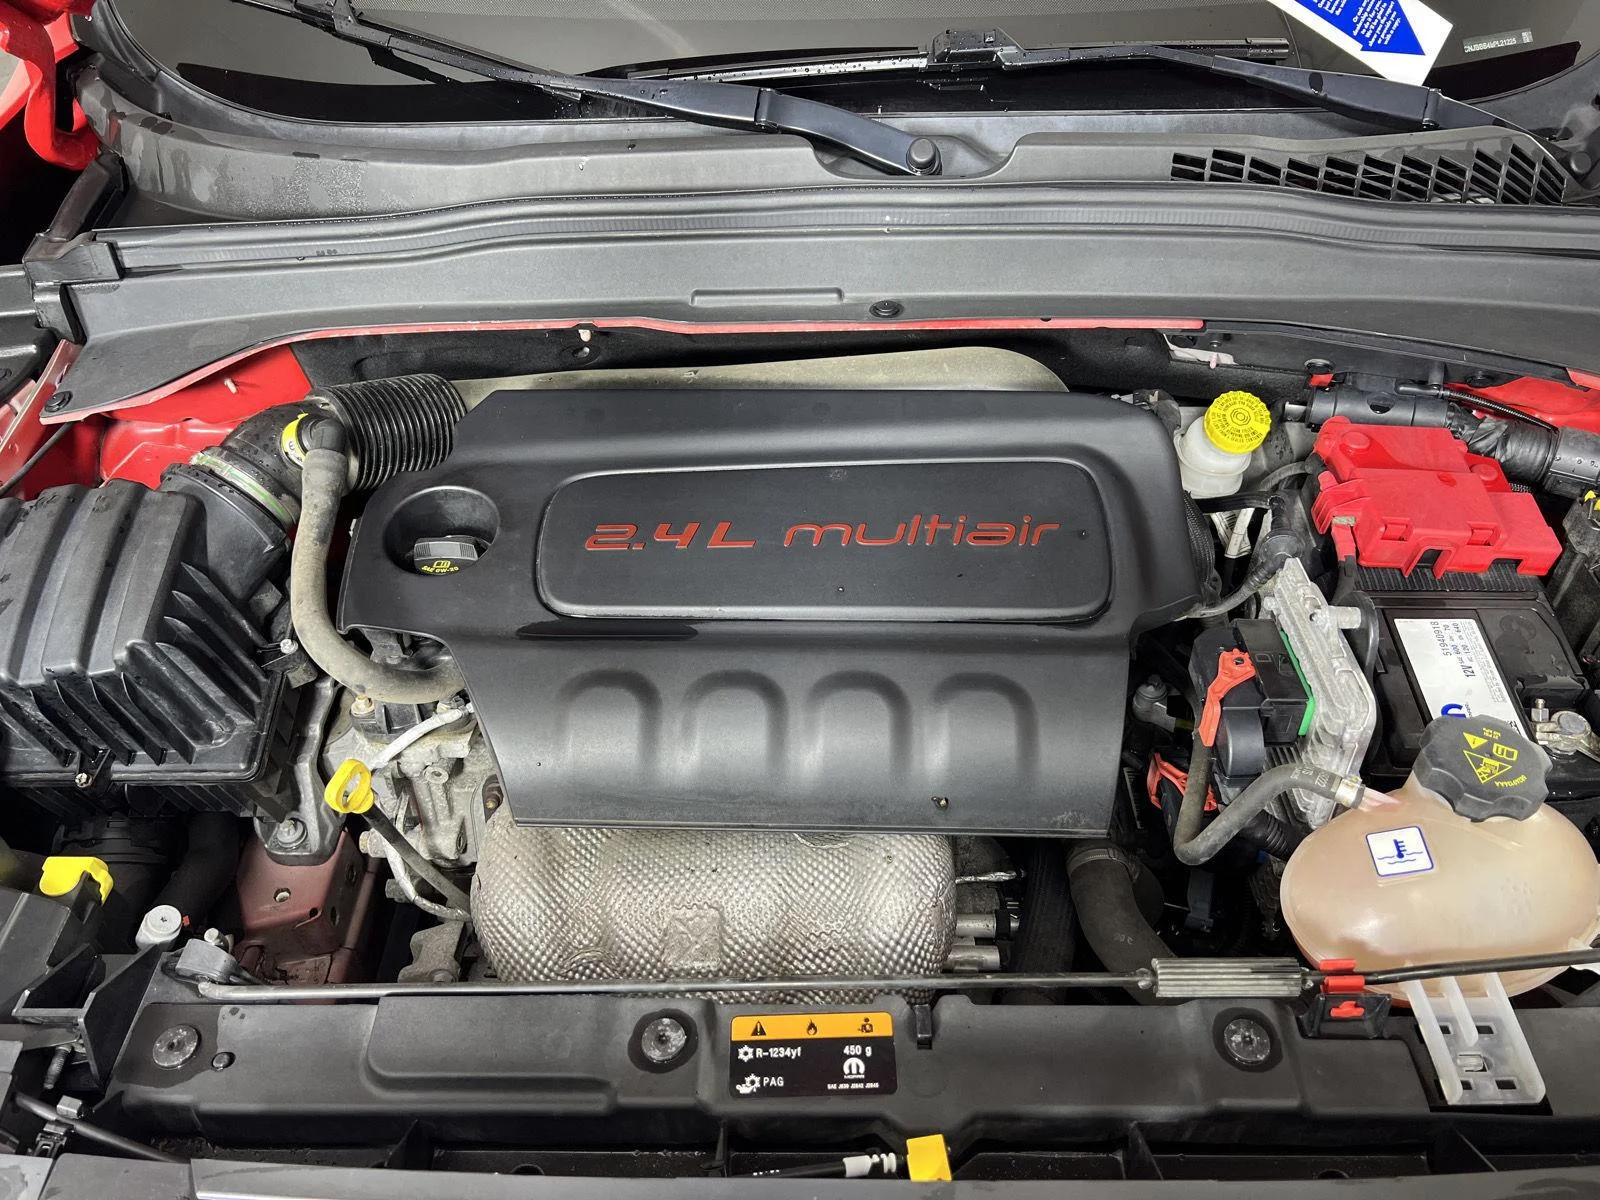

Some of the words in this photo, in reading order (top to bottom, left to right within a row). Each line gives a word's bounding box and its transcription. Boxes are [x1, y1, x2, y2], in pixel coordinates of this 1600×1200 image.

[784, 514, 1061, 547] multiair
[1430, 620, 1452, 656] 51940918
[1461, 664, 1475, 678] 12V
[755, 1047, 801, 1059] R-1234yf
[843, 1045, 862, 1056] 450
[865, 1046, 872, 1057] g
[763, 1077, 784, 1087] PAG
